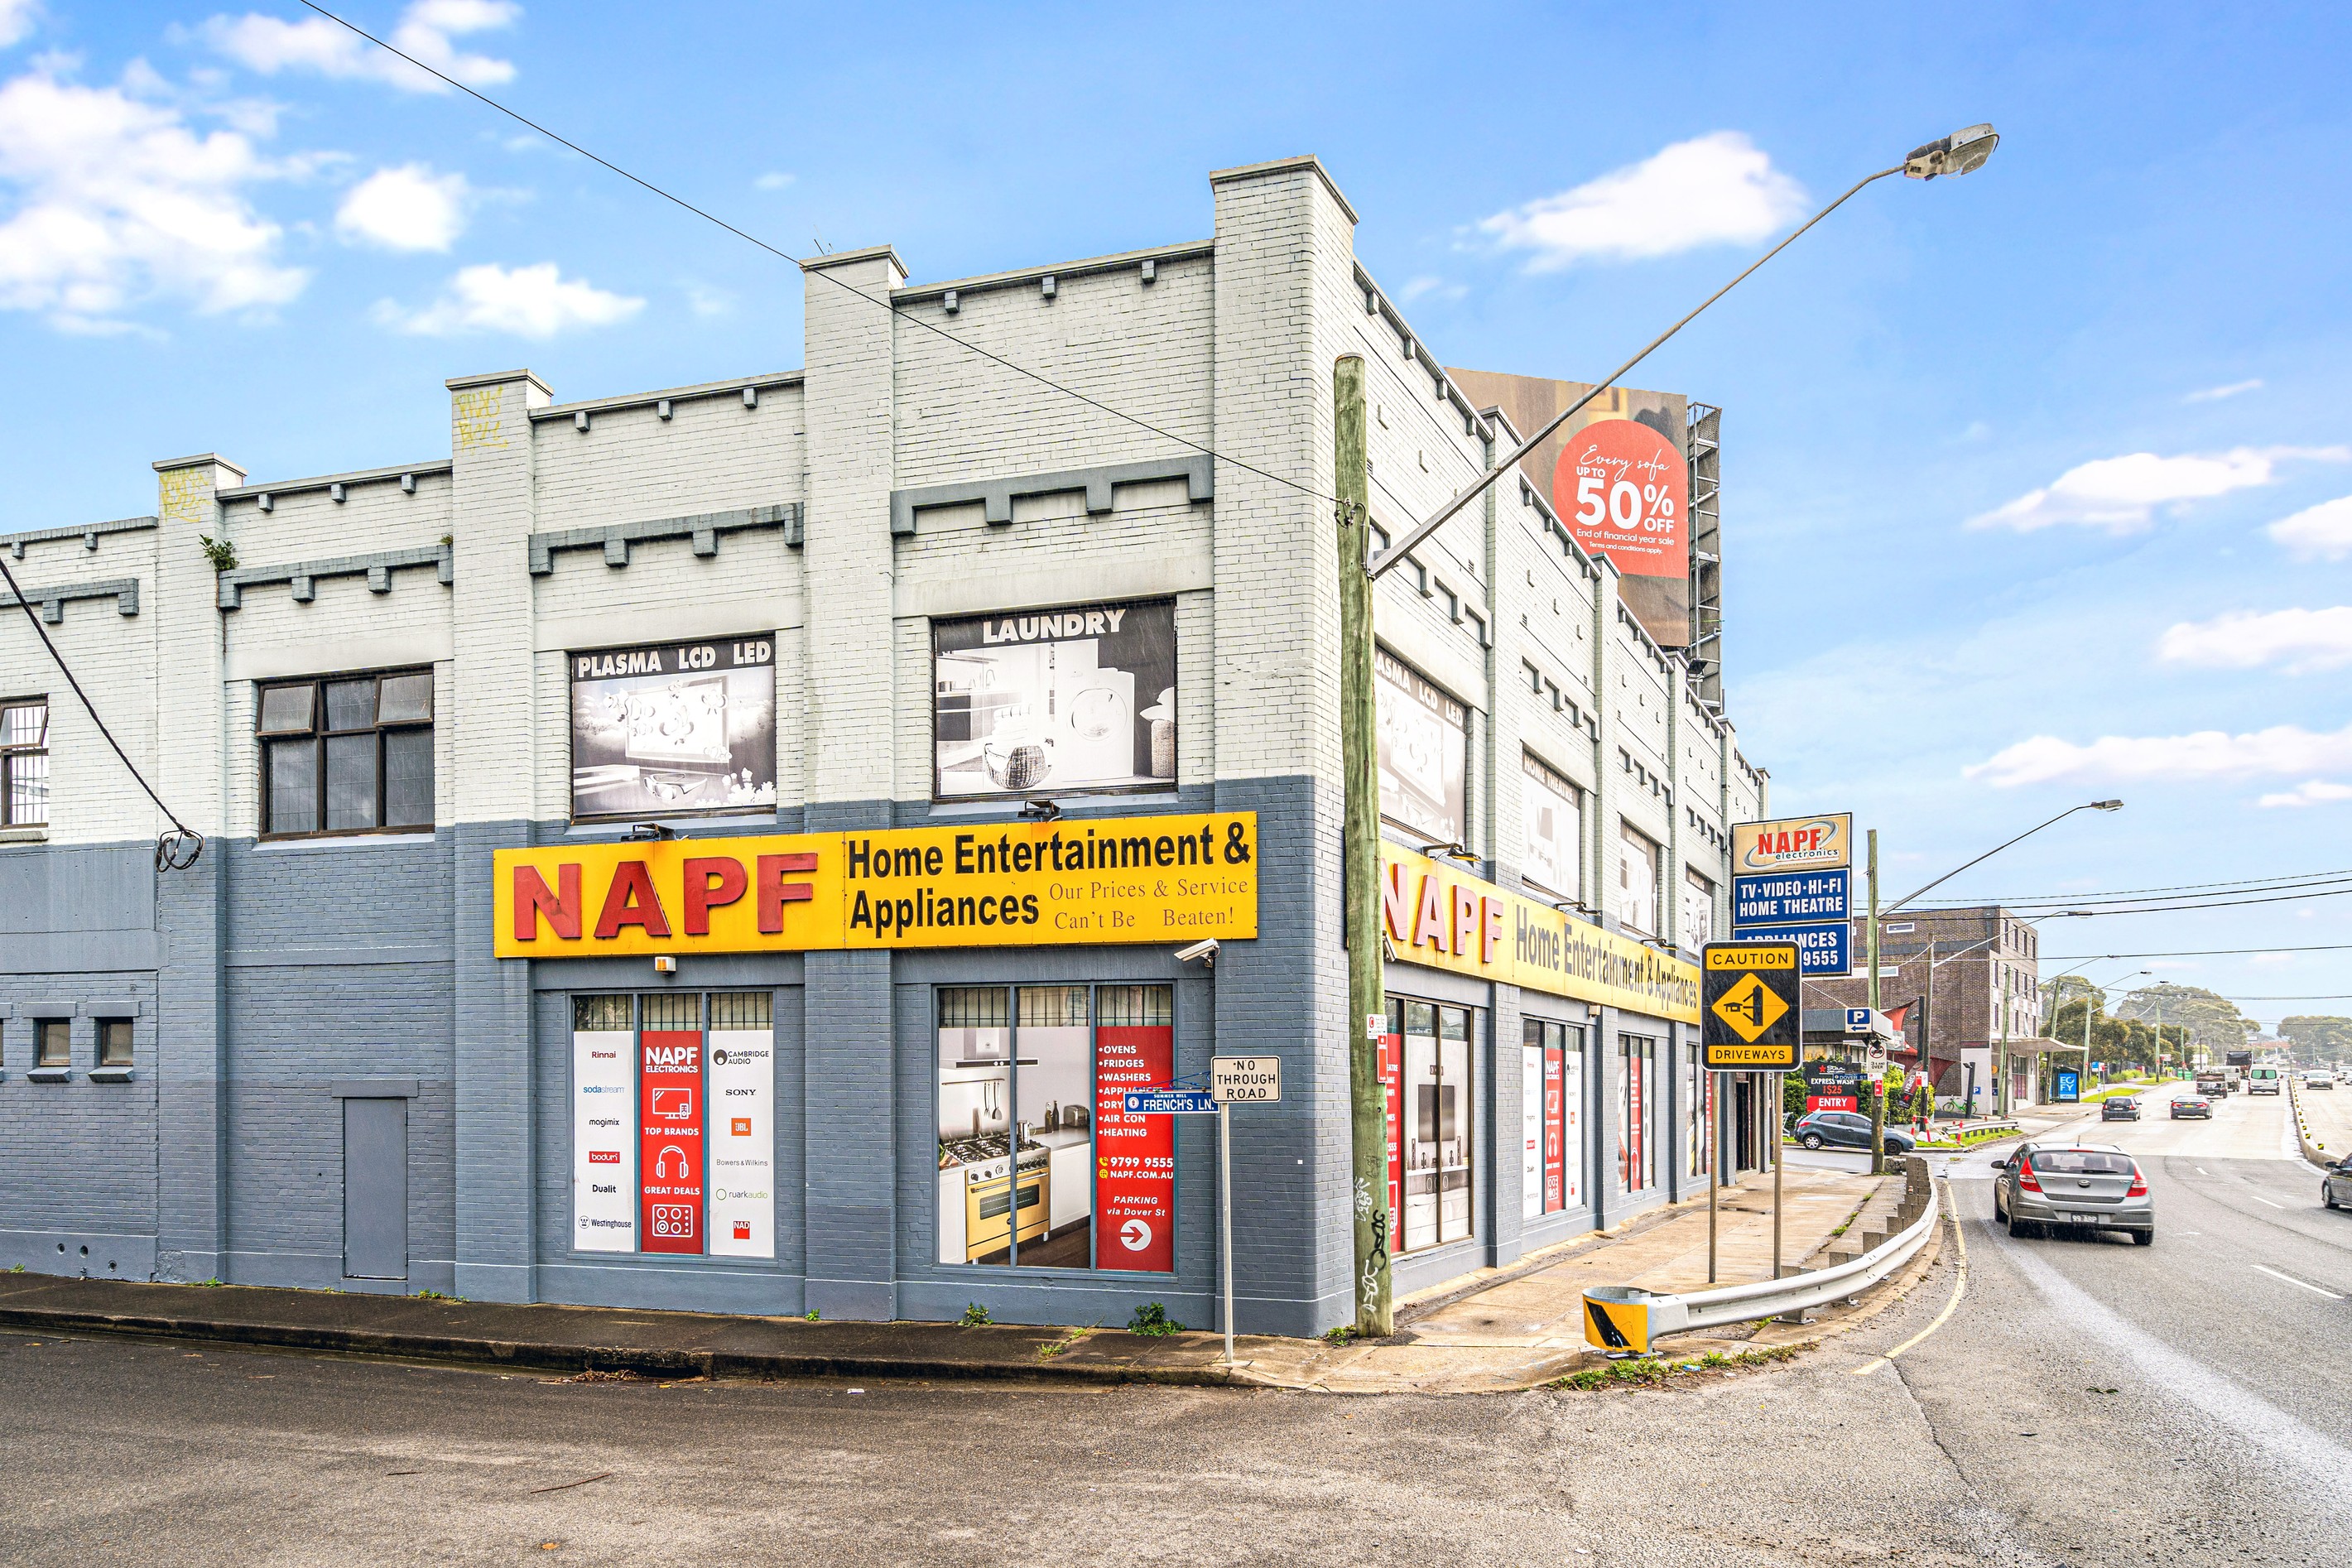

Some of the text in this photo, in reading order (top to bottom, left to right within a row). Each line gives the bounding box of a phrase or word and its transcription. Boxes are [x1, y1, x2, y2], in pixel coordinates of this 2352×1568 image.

[1580, 445, 1670, 482] Every sofa
[1576, 466, 1606, 478] UP TO
[1575, 477, 1674, 530] 50%
[1644, 517, 1675, 533] OFF
[1576, 528, 1675, 546] End of financial year sale
[1618, 544, 1646, 552] conditions
[983, 608, 1127, 644] LAUNDRY
[578, 641, 771, 678] PLASMA LCD LED
[1374, 652, 1464, 728] ASMA LCD LED
[1524, 757, 1574, 804] HOME THEATRE
[849, 821, 1252, 879] Home Entertainment &
[1775, 849, 1838, 860] electronics
[1049, 876, 1248, 901] Our Prices & Service
[513, 852, 819, 940] NAPF
[1381, 858, 1504, 964] NAPF
[1739, 896, 1844, 917] HOME THEATRE
[849, 887, 1040, 938] Appliances
[1054, 907, 1234, 931] Can't Be Beaten!
[1515, 904, 1698, 1012] Home Entertainment & Appliances
[1713, 953, 1788, 965] CAUTION
[1802, 950, 1839, 966] 9555
[1853, 1011, 1865, 1022] P
[591, 1051, 617, 1059] Rinnai
[1104, 1045, 1137, 1054] OVENS
[1715, 1050, 1786, 1060] DRIVEWAYS
[645, 1046, 699, 1065] NAPF
[1104, 1059, 1144, 1068] FRIDGES
[1236, 1060, 1255, 1070] NO
[645, 1065, 699, 1074] ELECTRONICS
[1104, 1073, 1152, 1081] WASHERS
[1216, 1074, 1276, 1085] THROUGH
[583, 1085, 624, 1094] sodastream
[1904, 1075, 1916, 1093] OPEN
[1226, 1087, 1267, 1099] ROAD
[1143, 1099, 1214, 1111] FRENCH'S LN.
[1818, 1098, 1848, 1107] ENTRY
[589, 1118, 620, 1128] magimix
[1104, 1114, 1146, 1123] AIR CON
[644, 1127, 700, 1136] TOP BRANDS
[734, 1122, 748, 1132] JBL
[1104, 1128, 1147, 1137] HEATING
[591, 1152, 618, 1161] bodum
[716, 1158, 740, 1166] Bowers
[744, 1158, 768, 1166] Wilkins
[1110, 1157, 1174, 1168] 9799 9555
[1110, 1170, 1174, 1179] NAPF.COM.AU
[592, 1184, 617, 1193] Dualit
[644, 1186, 700, 1195] GREAT DEALS
[1113, 1195, 1158, 1205] PARKING
[1123, 1208, 1152, 1216] Dover
[1155, 1209, 1166, 1217] St
[590, 1219, 632, 1229] Westinghouse
[733, 1221, 751, 1229] NAD
